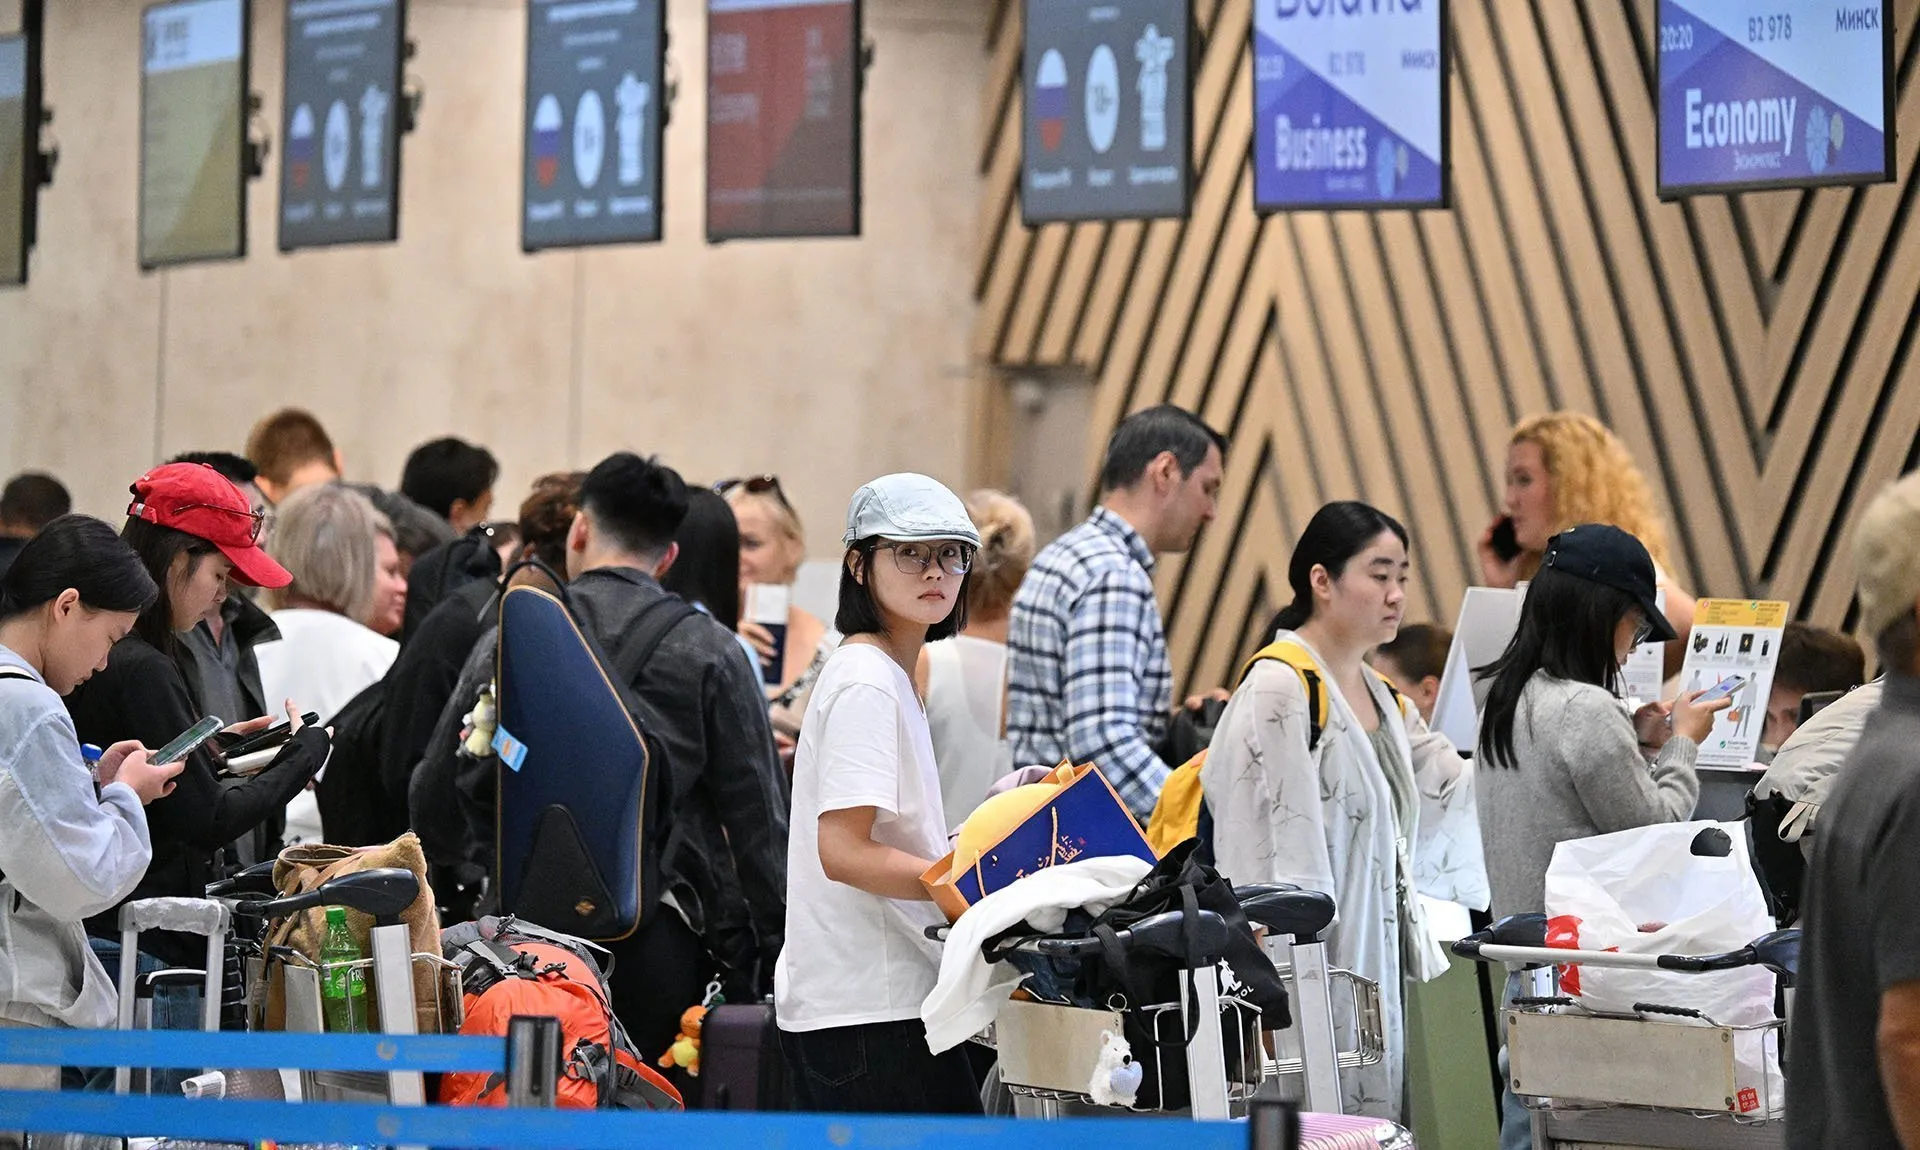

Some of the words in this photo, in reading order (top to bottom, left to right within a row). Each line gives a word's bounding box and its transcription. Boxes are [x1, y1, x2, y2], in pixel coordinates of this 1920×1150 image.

[1748, 16, 1764, 42] B2
[1768, 13, 1792, 40] 978
[1275, 113, 1367, 171] Business
[1686, 88, 1797, 156] Economy
